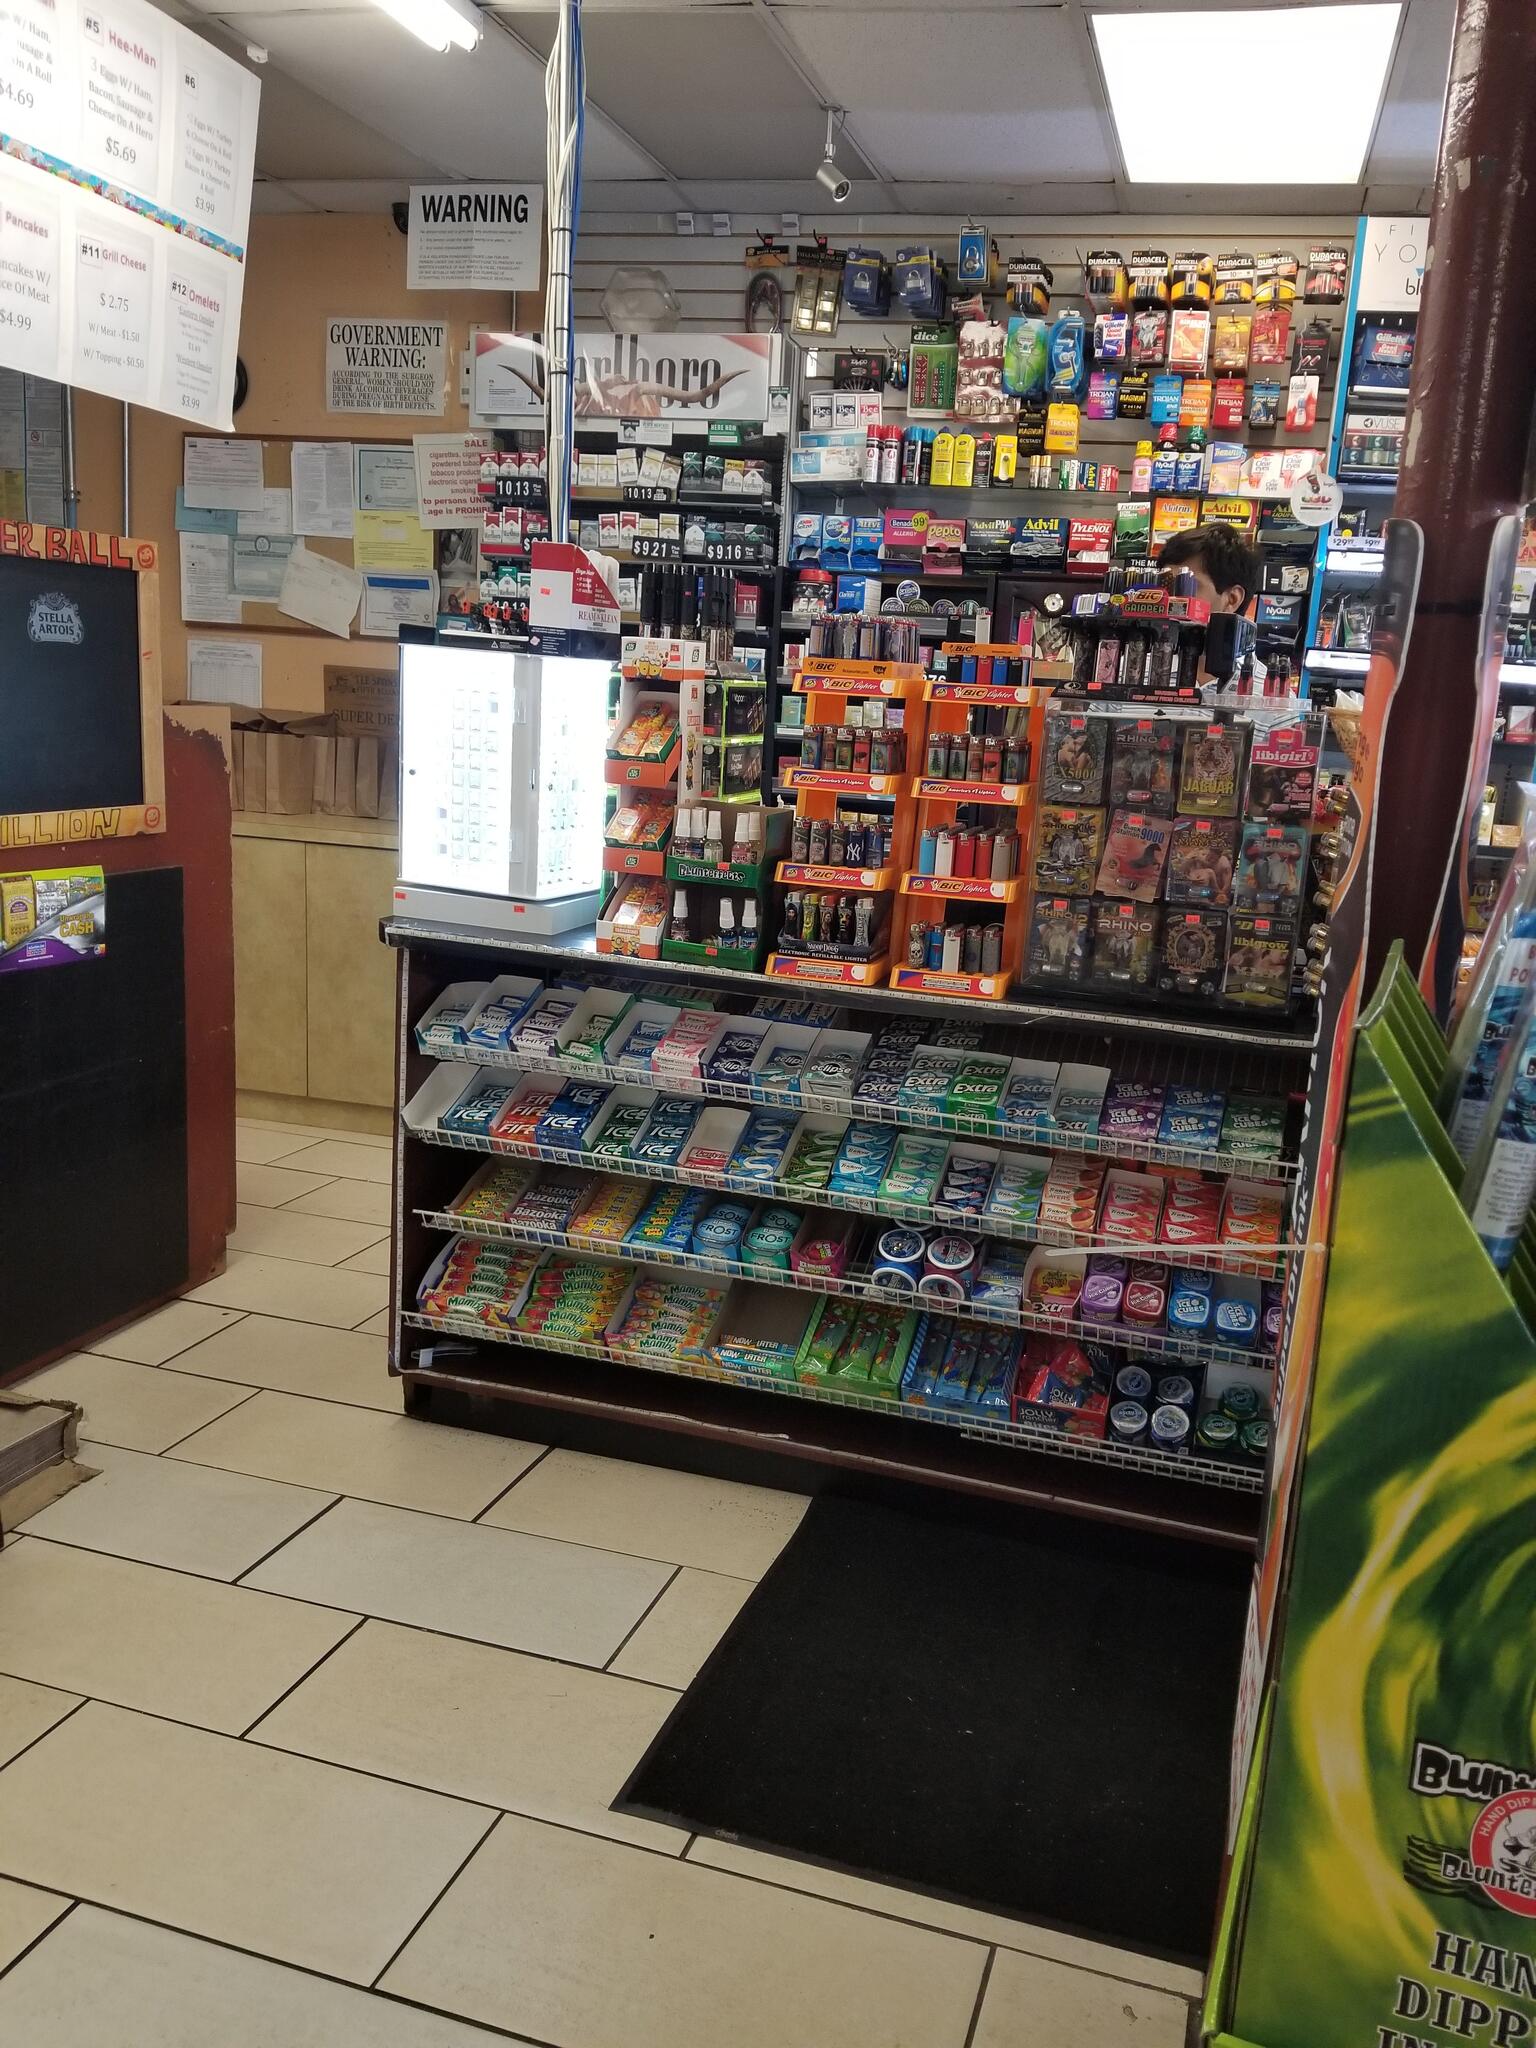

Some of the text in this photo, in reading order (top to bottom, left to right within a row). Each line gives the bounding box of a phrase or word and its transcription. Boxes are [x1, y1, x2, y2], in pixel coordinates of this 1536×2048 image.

[86, 17, 100, 34] #5
[109, 29, 157, 69] Hee-Man
[185, 74, 196, 89] #6
[0, 79, 34, 109] $4.69
[88, 99, 116, 122] Cheese
[106, 136, 137, 164] $5.69
[195, 196, 215, 215] $3.99
[421, 193, 529, 224] WARNING
[5, 211, 49, 239] Pancakes
[81, 243, 147, 272] #11 Grill Cheese
[1088, 258, 1122, 266] DURACELL
[1132, 256, 1167, 265] DURACELL
[1257, 256, 1293, 267] DURACELL
[1310, 252, 1346, 261] DURACELL
[1009, 263, 1042, 271] DURACELL
[1218, 258, 1252, 268] DURACELL
[36, 269, 51, 286] W/
[27, 286, 50, 304] Meat
[172, 280, 220, 312] #12 Omelets
[108, 295, 129, 312] 2.75
[0, 310, 32, 331] $4.99
[330, 324, 444, 347] GOVERNMENT
[913, 332, 938, 342] dice
[96, 350, 122, 365] Topping
[345, 346, 426, 369] WARNING:
[333, 370, 370, 378] ACCORDING
[385, 372, 398, 380] THE
[366, 379, 391, 387] WOMEN
[393, 380, 420, 388] SHOULD
[421, 381, 435, 389] NOT
[182, 395, 200, 410] $3.99
[359, 393, 398, 401] PREGNANCY
[400, 394, 428, 402] BECAUSE
[1153, 395, 1179, 403] TROJAN
[1181, 399, 1208, 407] TROJAN
[1217, 399, 1243, 407] TROJAN
[357, 400, 371, 408] RISK
[814, 406, 832, 417] Bee
[836, 405, 855, 416] Bee
[861, 405, 879, 416] Bee
[464, 440, 488, 448] SALE
[1155, 461, 1174, 470] NyQuil
[1179, 462, 1196, 471] NyQuil
[451, 487, 476, 495] smoking
[428, 508, 443, 516] age
[1211, 502, 1241, 514] Advil
[972, 520, 995, 530] Advil
[1024, 518, 1059, 531] Advil
[1072, 522, 1112, 534] TYLENOL
[45, 526, 136, 570] BALL
[634, 540, 667, 557] $9.21
[707, 544, 742, 560] $9.16
[1293, 574, 1300, 582] 2
[1136, 591, 1160, 602] BIC
[1266, 606, 1291, 616] NyQuil
[38, 610, 73, 625] STELLA
[38, 622, 75, 636] ARTOIS
[814, 663, 836, 672] BIC
[830, 681, 852, 689] BIC
[963, 689, 985, 697] BIC
[1116, 734, 1157, 744] RHINO
[1255, 749, 1307, 763] libigirl
[799, 774, 818, 783] BIC
[928, 784, 948, 792] BIC
[1183, 778, 1234, 795] JAGUAR
[0, 807, 120, 846] ILLION
[1141, 827, 1164, 843] 9000
[812, 871, 833, 879] BIC
[939, 882, 961, 890] BIC
[60, 921, 94, 937] CASH
[1099, 919, 1153, 932] RHINO
[778, 949, 867, 963] ELECTRONIC REFILLABLE LIGHTER
[811, 1063, 853, 1075] eclipse
[905, 1075, 949, 1088] Extra
[858, 1081, 900, 1094] Extra
[953, 1083, 998, 1095] Extra
[454, 1110, 489, 1121] ICE
[1110, 1114, 1144, 1125] CUBES
[543, 1116, 581, 1128] ICE
[1170, 1122, 1205, 1132] CUBES
[639, 1144, 682, 1156] ICE
[841, 1163, 864, 1172] Trident
[888, 1182, 910, 1191] Trident
[514, 1206, 567, 1220] Bazooka
[991, 1207, 1017, 1215] Trident
[1111, 1208, 1135, 1217] Trident
[700, 1224, 738, 1235] FROST
[1169, 1227, 1195, 1236] Trident
[1230, 1222, 1256, 1231] Trident
[751, 1232, 791, 1243] FROST
[564, 1267, 606, 1280] Mamba
[448, 1295, 486, 1313] Mamba
[543, 1322, 582, 1338] Mamba
[651, 1320, 688, 1335] Mamba
[720, 1349, 740, 1359] NOW
[1020, 1408, 1053, 1417] JOLLY
[1479, 1804, 1506, 1837] HAND
